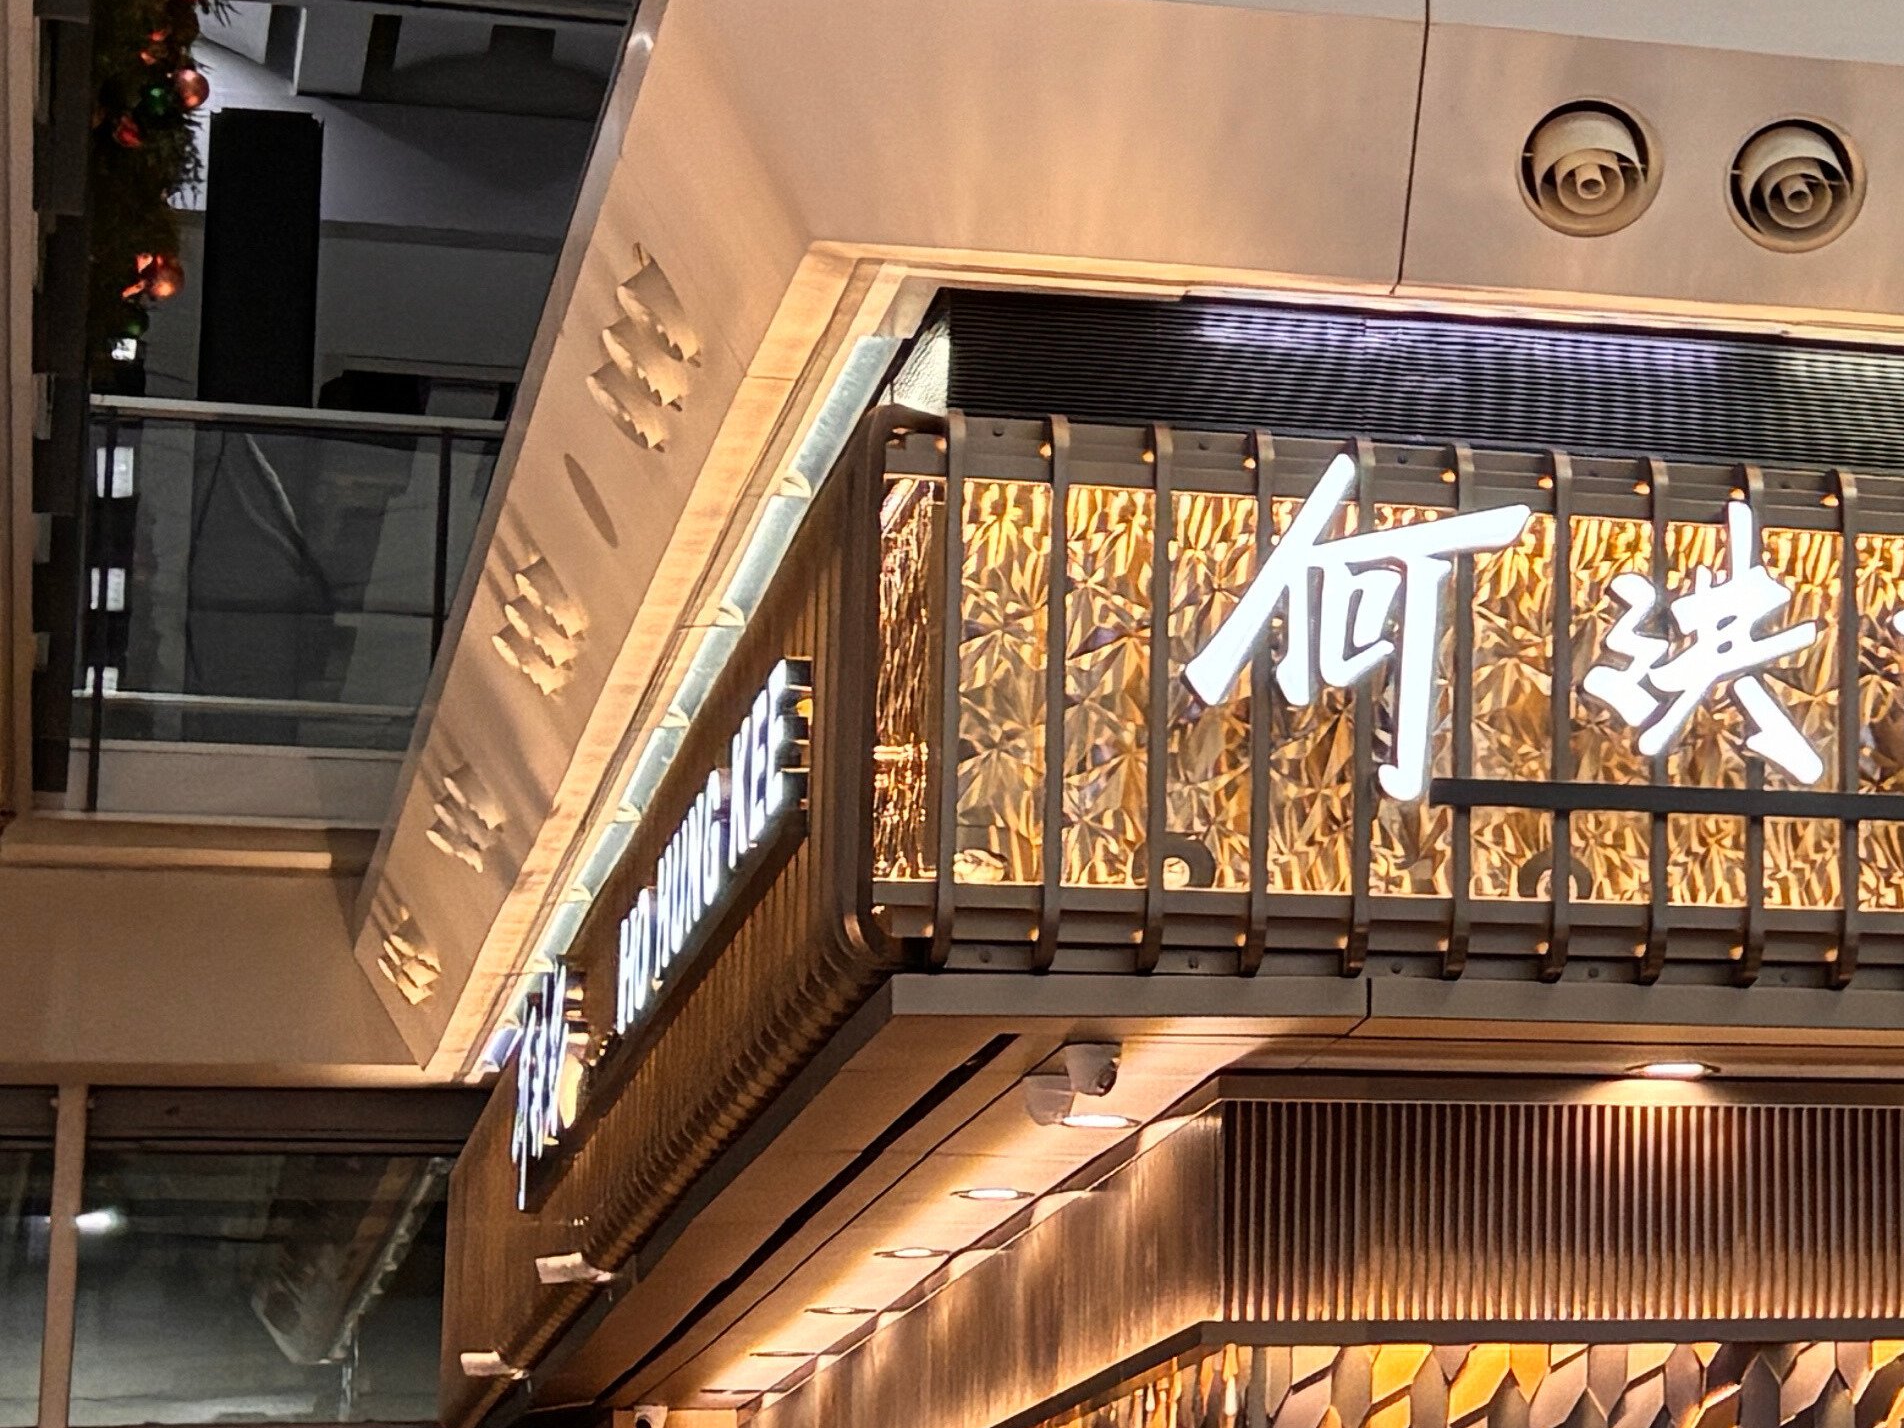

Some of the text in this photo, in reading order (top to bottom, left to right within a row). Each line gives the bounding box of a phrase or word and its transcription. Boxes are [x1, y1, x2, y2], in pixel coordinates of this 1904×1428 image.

[617, 659, 789, 1034] HO HUNG KEE
